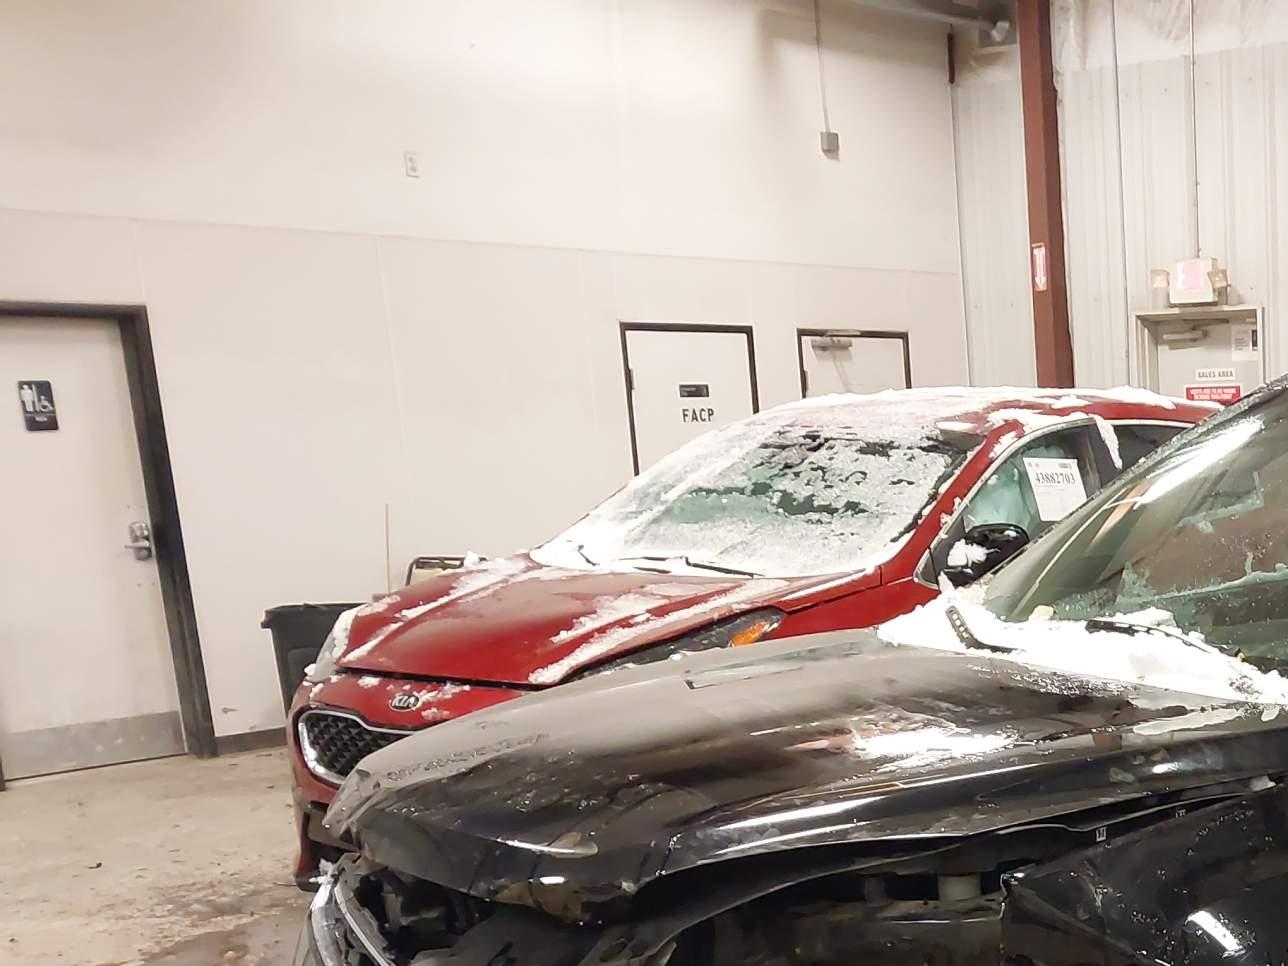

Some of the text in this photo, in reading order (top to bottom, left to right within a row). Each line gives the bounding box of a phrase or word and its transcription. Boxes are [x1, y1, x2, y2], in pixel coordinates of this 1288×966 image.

[682, 408, 714, 422] FACP
[1035, 471, 1075, 484] 43882703
[392, 695, 417, 707] KIA
